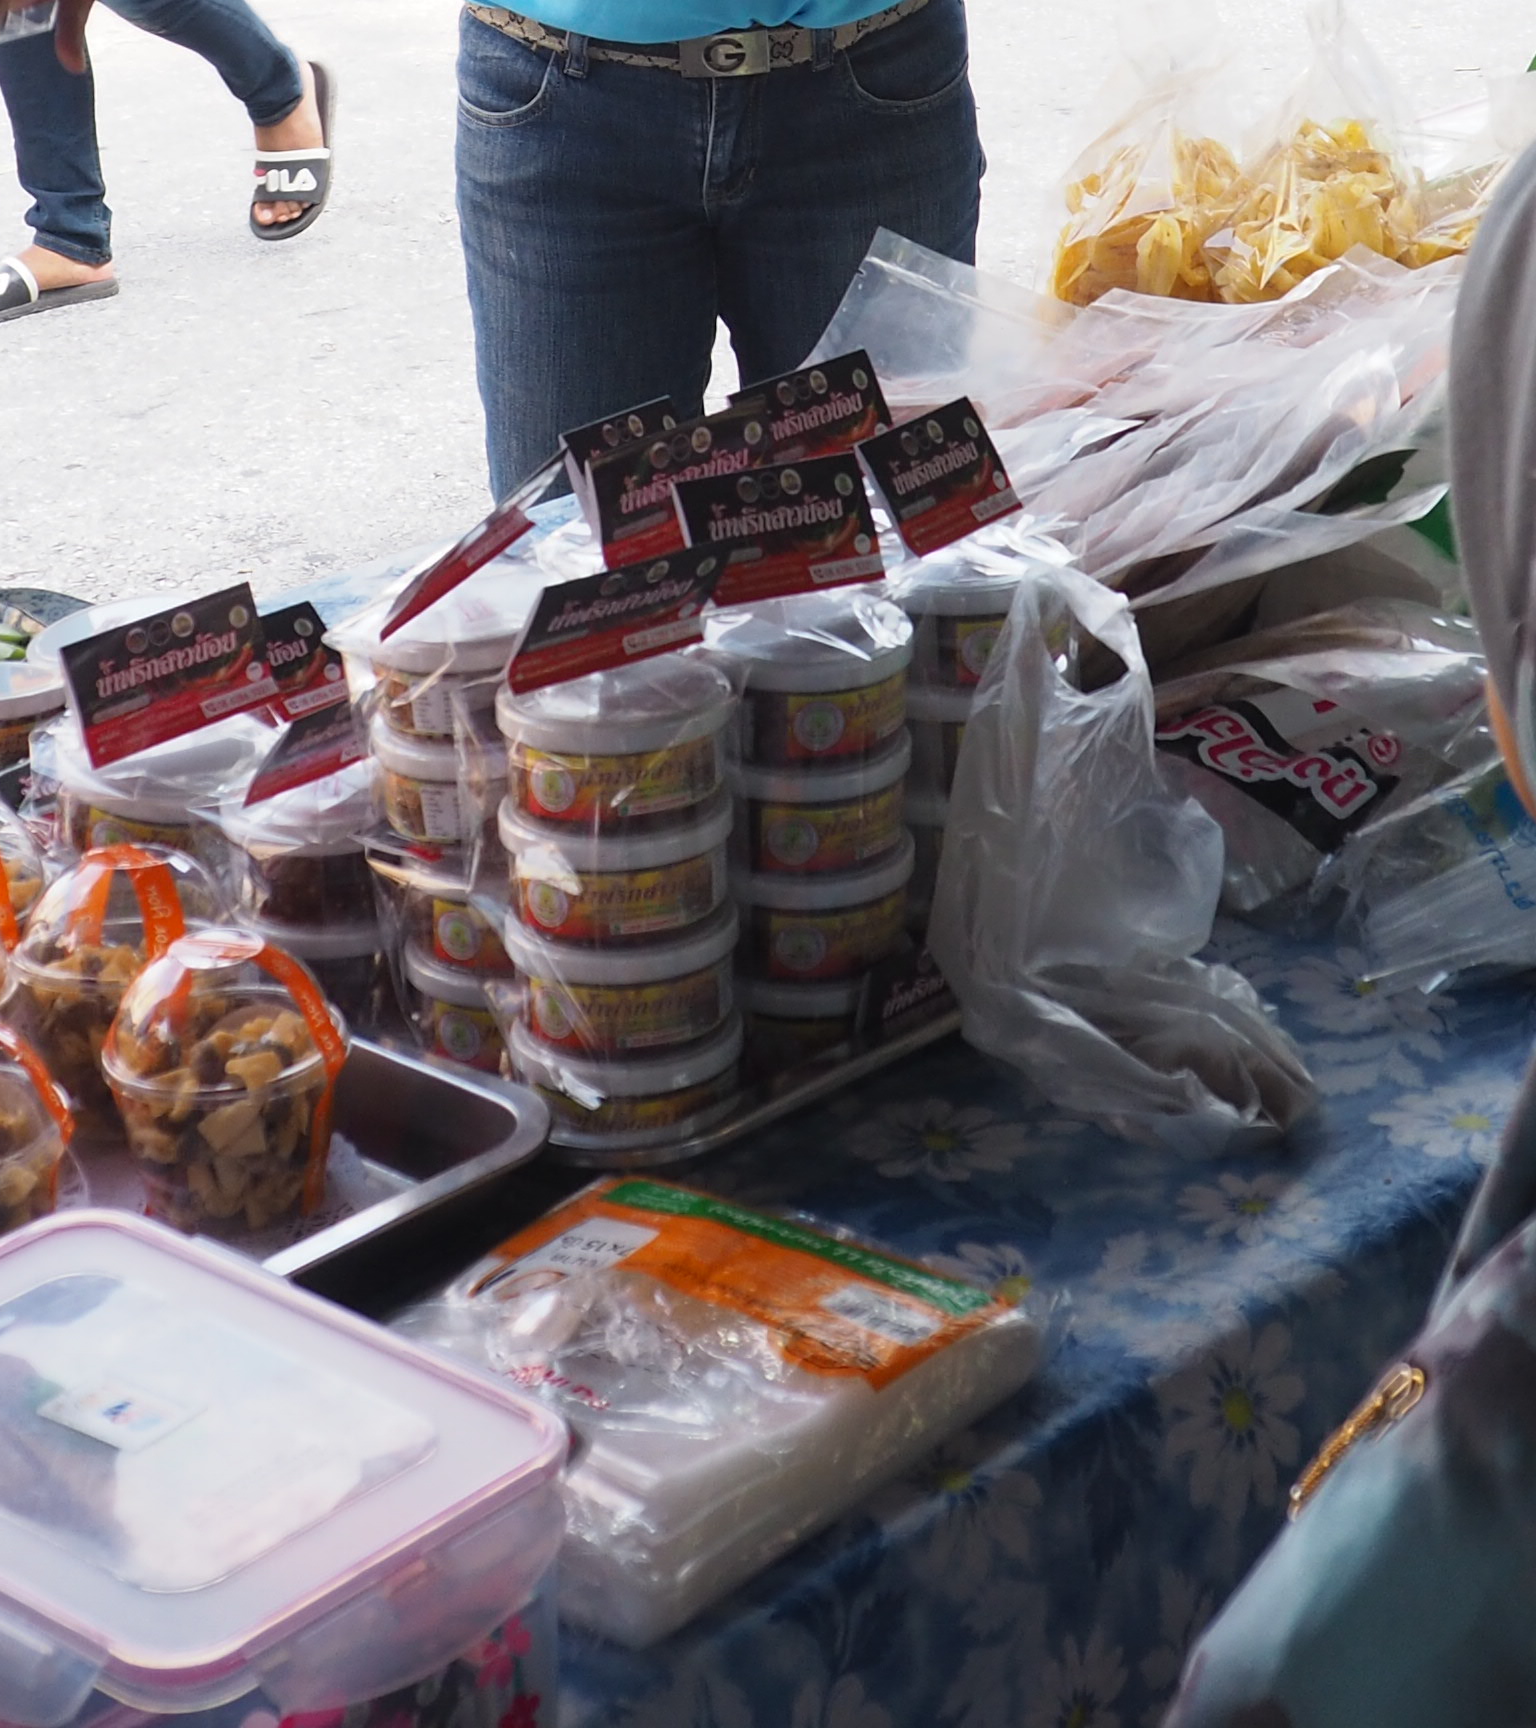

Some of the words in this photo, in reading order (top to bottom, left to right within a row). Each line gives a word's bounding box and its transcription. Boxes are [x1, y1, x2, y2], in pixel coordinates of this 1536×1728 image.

[96, 629, 238, 699] น้ำพริกสาวน้อย
[266, 637, 309, 668] น้อย
